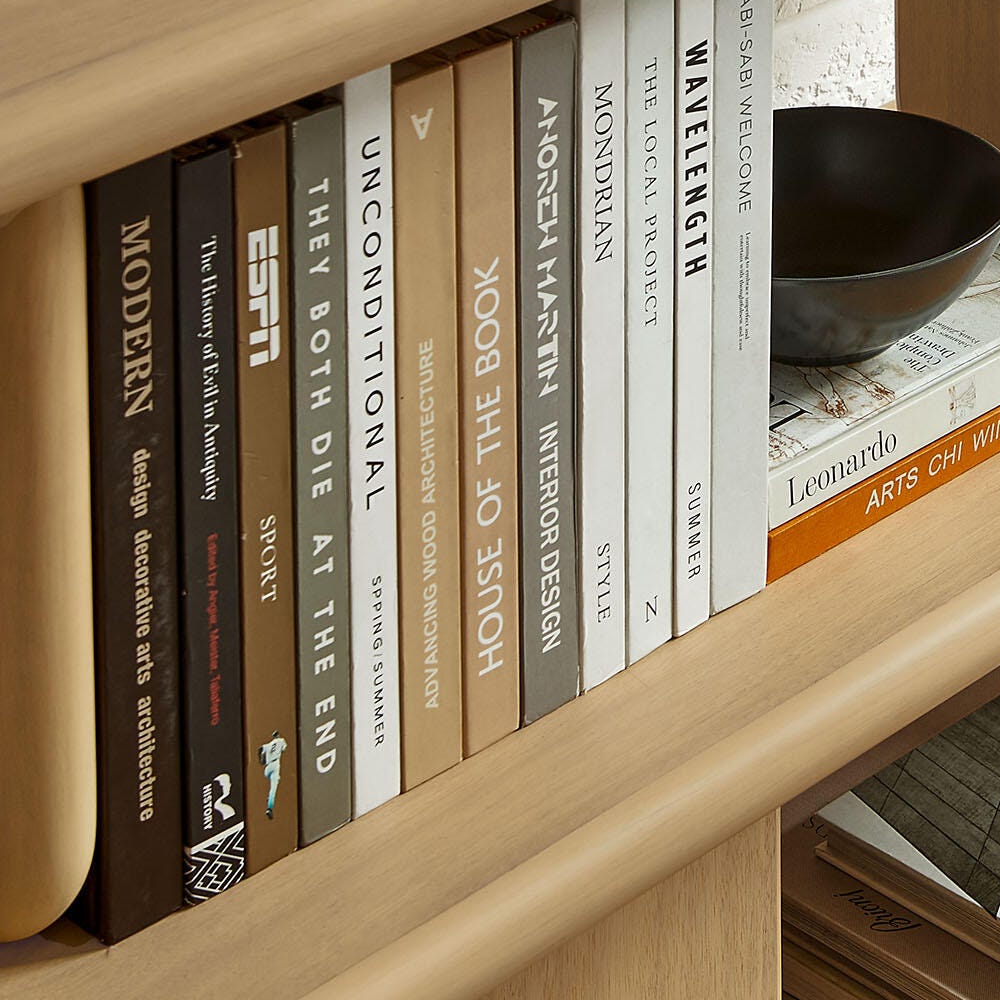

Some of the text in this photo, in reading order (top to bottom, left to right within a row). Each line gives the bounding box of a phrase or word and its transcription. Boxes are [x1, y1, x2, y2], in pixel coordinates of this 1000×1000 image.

[594, 81, 613, 264] MONDRIAN
[644, 56, 657, 327] THE LOCAL PROJECT
[685, 39, 708, 278] WAVELENGTH
[738, 95, 752, 213] WELCOME
[248, 225, 280, 367] ESPN
[361, 135, 385, 511] UNCONDITIONAL
[537, 256, 558, 399] MARTIN
[896, 341, 941, 365] Comple
[909, 333, 956, 358] Drawin
[197, 235, 221, 500] The History of Evil in Antiquity
[903, 358, 929, 373] The
[121, 215, 156, 822] MODERN design decorative arts architecture
[308, 178, 337, 774] THEY BOTH DIE AT THE END
[419, 338, 438, 709] ADVANCING WOOD ARCHITECTURE
[474, 256, 504, 677] HOUSE OF THE BOOK
[539, 420, 559, 549] INTERIOR
[787, 430, 897, 508] Leonardo
[865, 466, 919, 515] ARTS
[928, 440, 963, 476] CHI
[259, 514, 277, 602] SPORT
[596, 542, 611, 623] STYLE
[687, 482, 702, 580] SUMMER
[540, 549, 561, 655] DESIGN
[203, 783, 213, 830] HISTORY
[833, 889, 922, 933] Brioni
